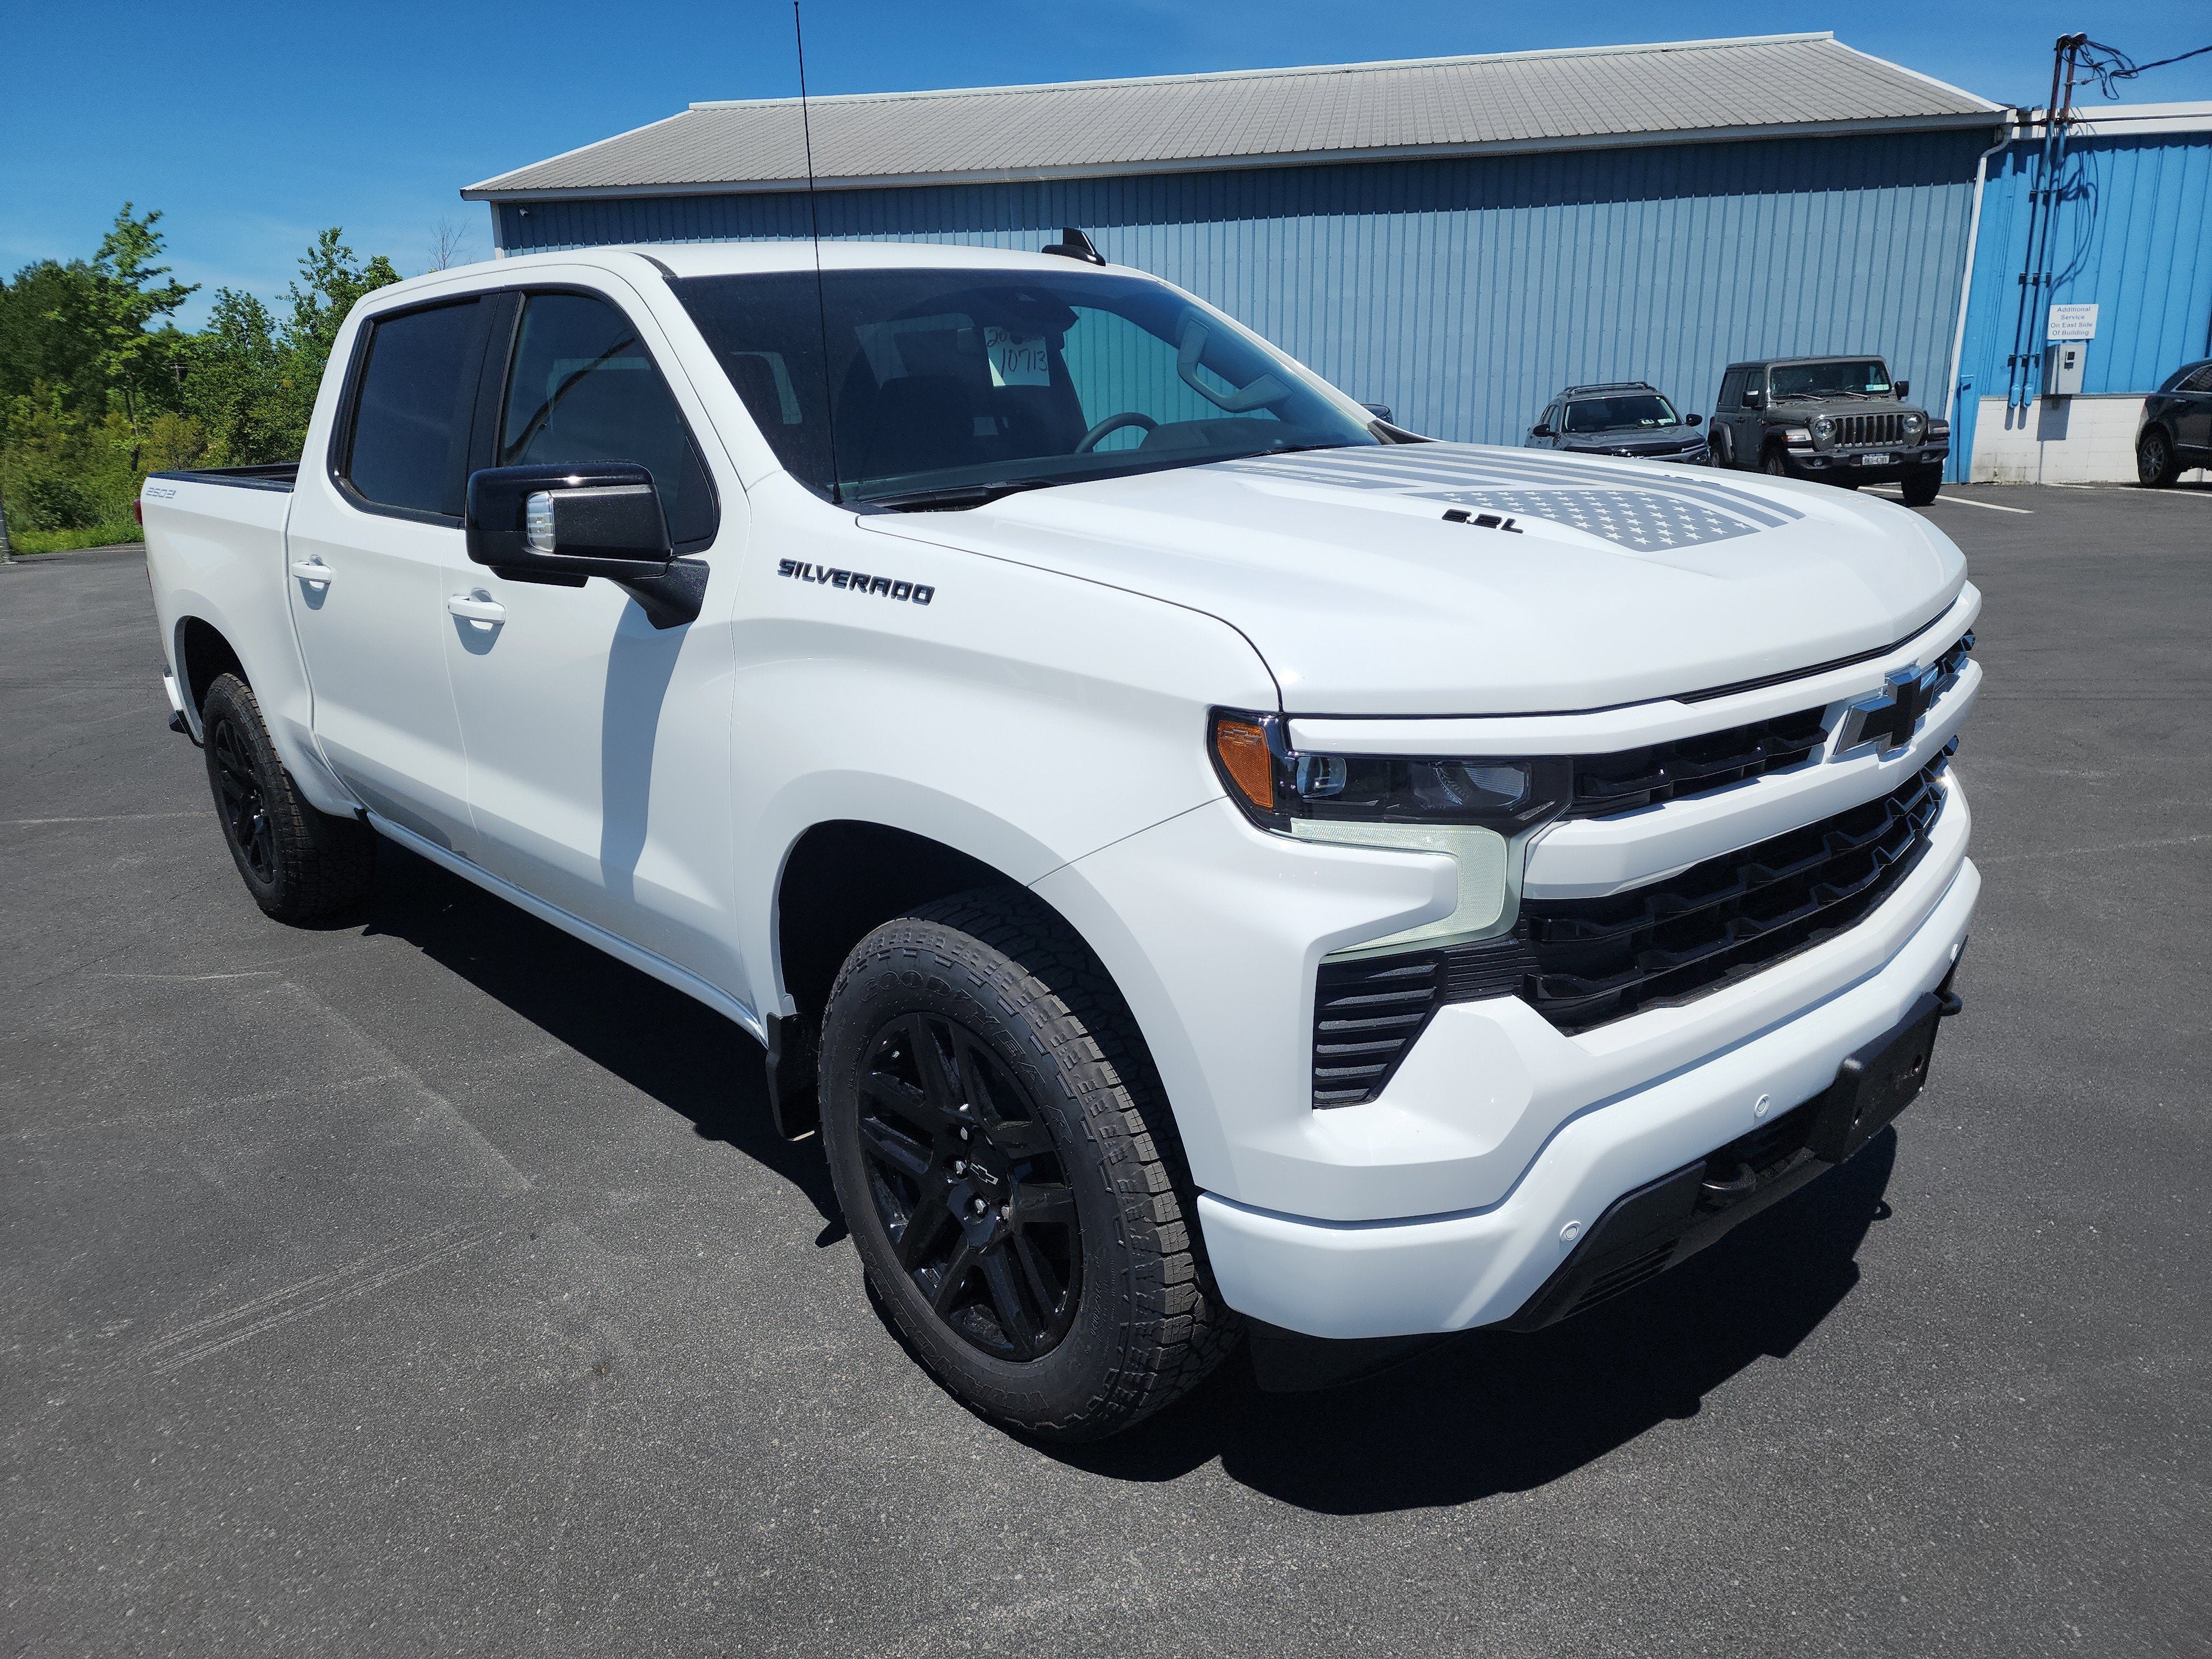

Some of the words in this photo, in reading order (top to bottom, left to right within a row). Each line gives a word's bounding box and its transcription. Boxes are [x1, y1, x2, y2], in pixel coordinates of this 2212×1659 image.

[1000, 348, 1048, 378] 10713
[777, 557, 936, 606] SILVERADO
[861, 970, 1073, 1144] GOODYEAR
